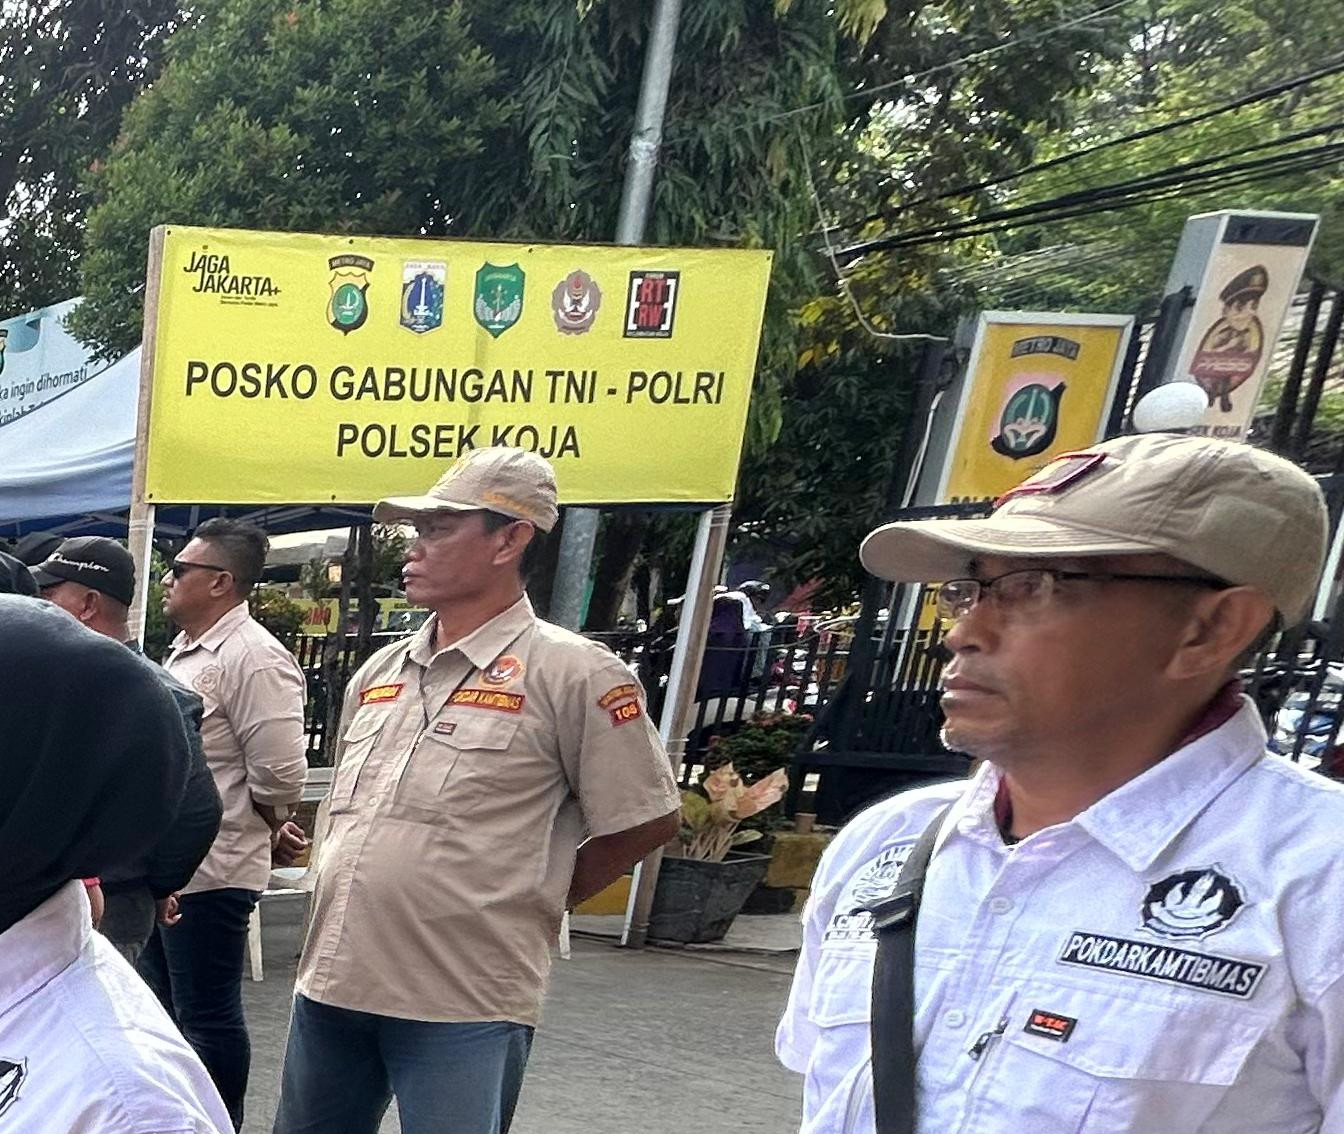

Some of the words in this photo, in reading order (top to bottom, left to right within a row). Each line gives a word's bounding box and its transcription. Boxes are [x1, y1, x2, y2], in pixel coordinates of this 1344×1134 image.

[183, 247, 230, 274] JAGA
[640, 279, 667, 303] RT
[637, 304, 663, 327] RW
[10, 377, 35, 401] ingin
[36, 366, 89, 392] dihormati
[185, 361, 317, 400] POSKO
[329, 365, 534, 404] GABUNGAN
[544, 369, 597, 405] TNI
[625, 371, 725, 406] POLRI
[336, 423, 481, 458] POLSEK
[491, 425, 581, 458] KOJA
[47, 552, 109, 572] Champion
[1062, 934, 1257, 993] POKDARKAMTIBMAS
